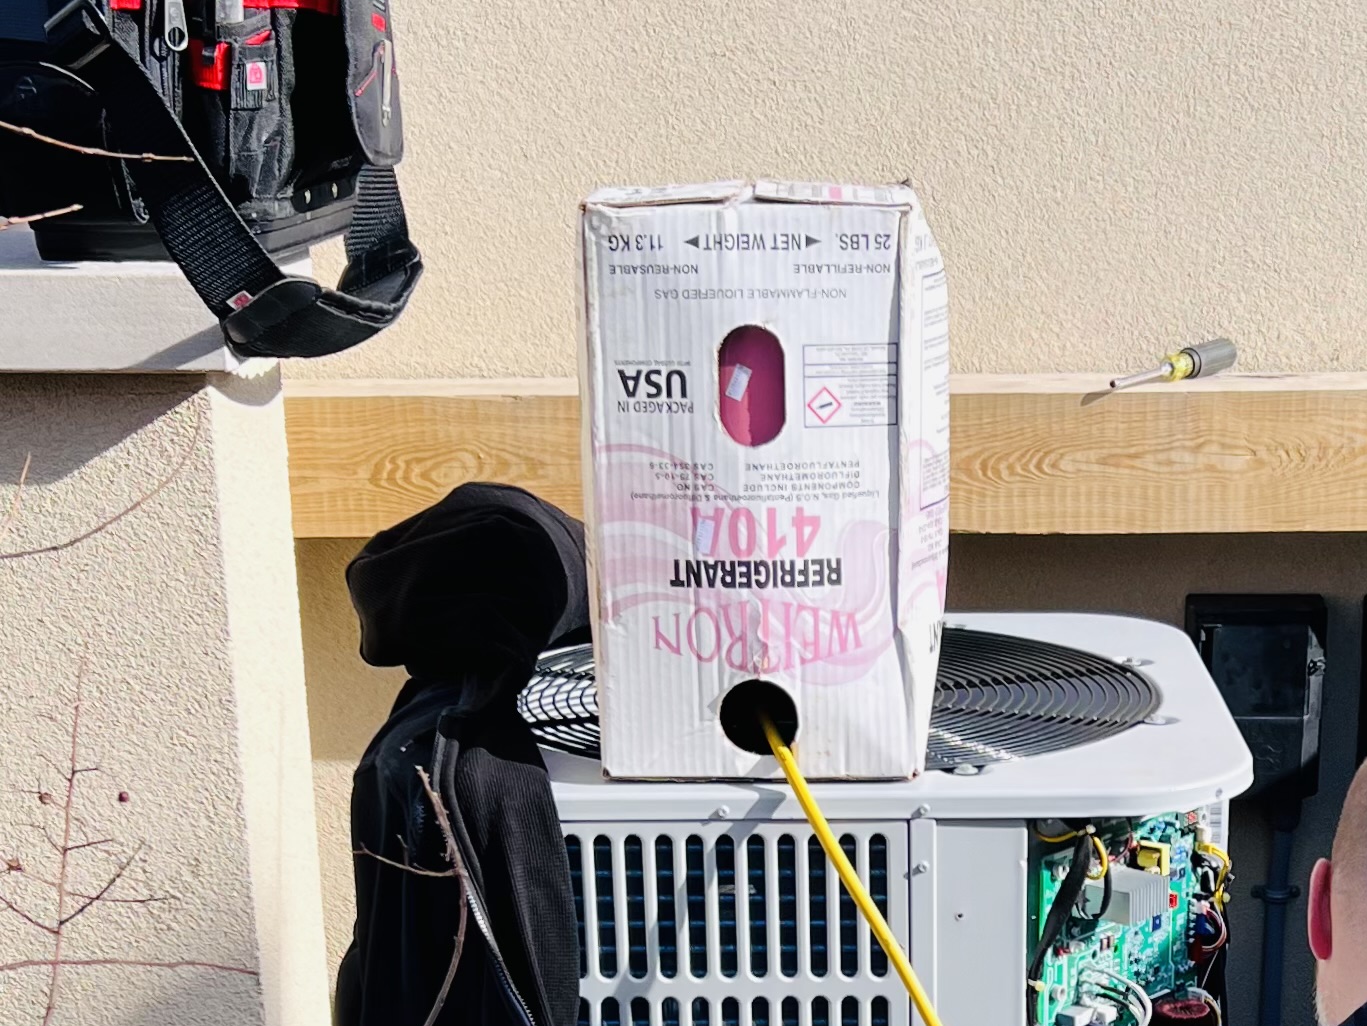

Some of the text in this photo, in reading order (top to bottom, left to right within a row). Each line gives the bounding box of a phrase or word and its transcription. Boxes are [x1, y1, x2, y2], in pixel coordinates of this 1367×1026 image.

[608, 233, 891, 252] 25 LBS. NET WEIGHT 11.3 KG
[608, 264, 699, 275] NON-REUSABLE
[793, 263, 891, 274] NON-REFILLABLE
[654, 288, 847, 300] NON-FLAMMABLE LIQUEFIED GAS
[617, 369, 688, 399] USA
[617, 400, 694, 414] PACKAGED IN
[745, 460, 860, 471] PENTAFLUOROETHANE
[760, 471, 860, 482] DIFLUOROMETHANE
[743, 481, 860, 492] COMPONENTS INCLUDE
[842, 490, 880, 499] Liquefied
[689, 506, 821, 558] 410A
[670, 558, 842, 589] REFRIGERANT
[651, 600, 863, 674] WEITRON
